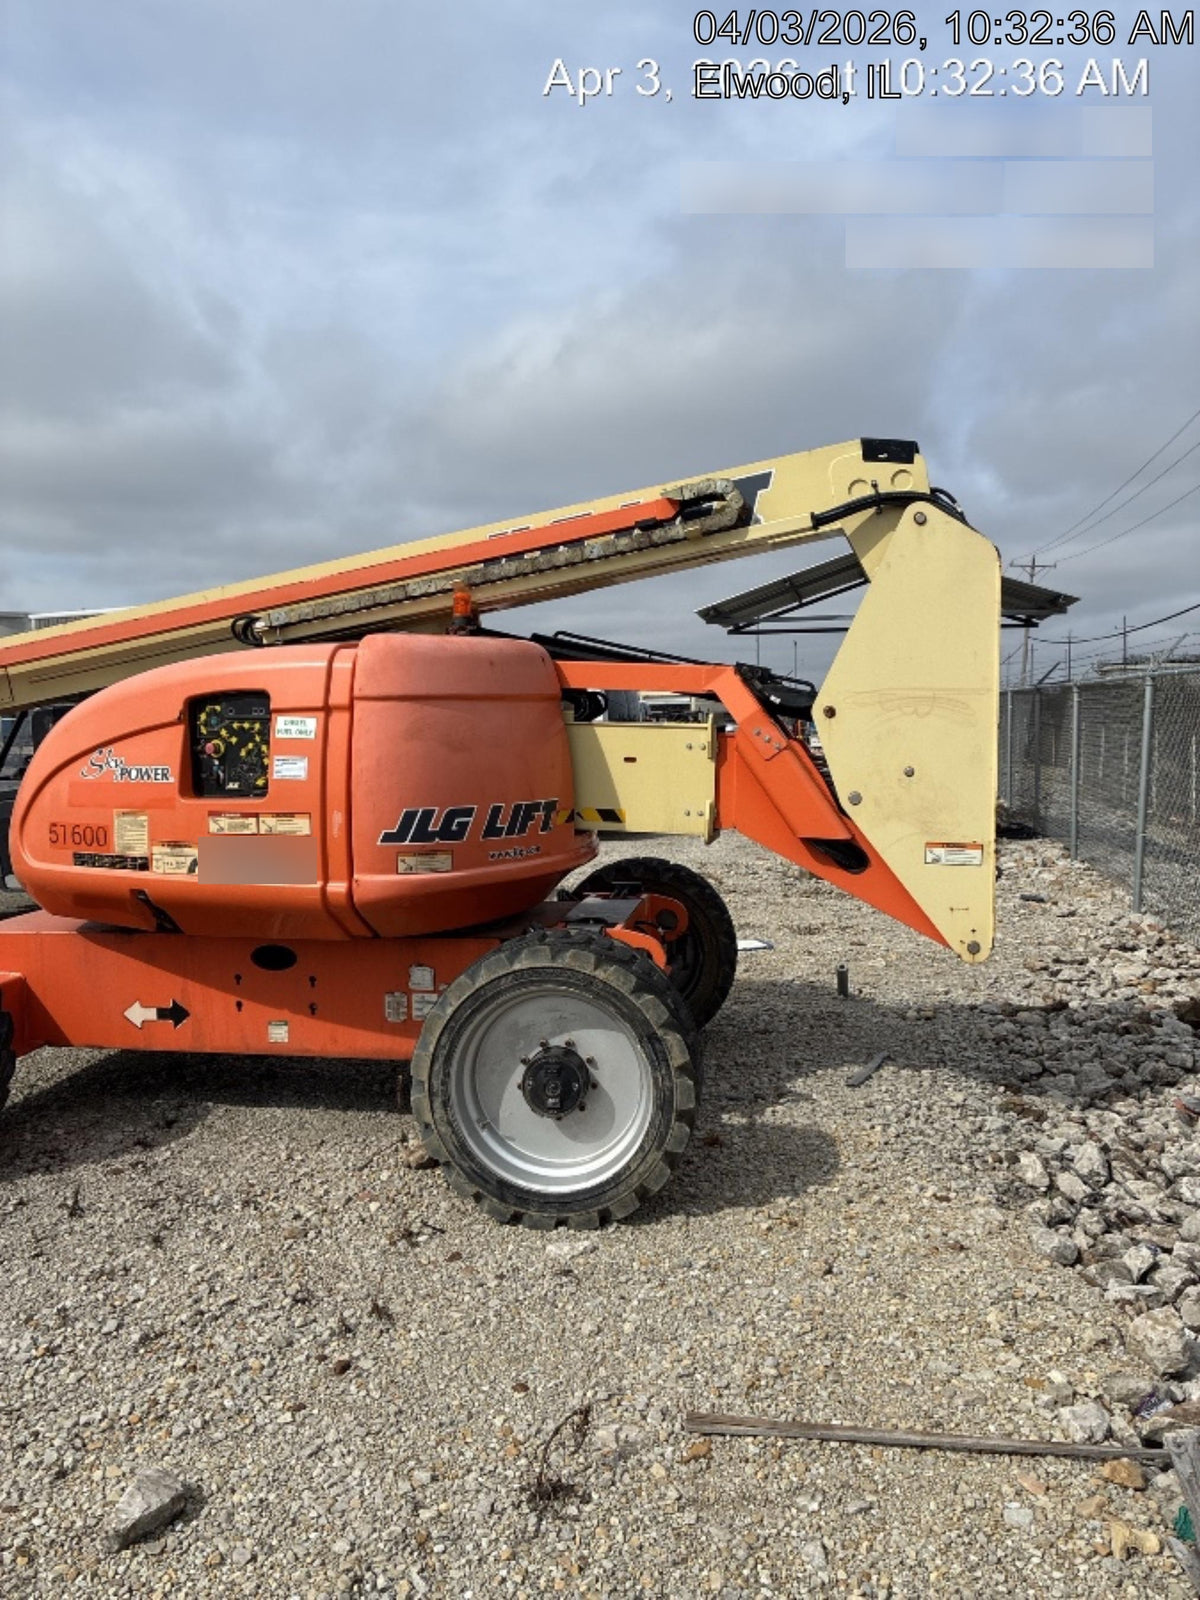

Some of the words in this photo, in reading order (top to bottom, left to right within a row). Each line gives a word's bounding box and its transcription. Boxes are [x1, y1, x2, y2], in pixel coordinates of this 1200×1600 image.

[48, 822, 108, 848] 51600
[376, 804, 478, 846] JLG
[479, 797, 560, 842] LIFT
